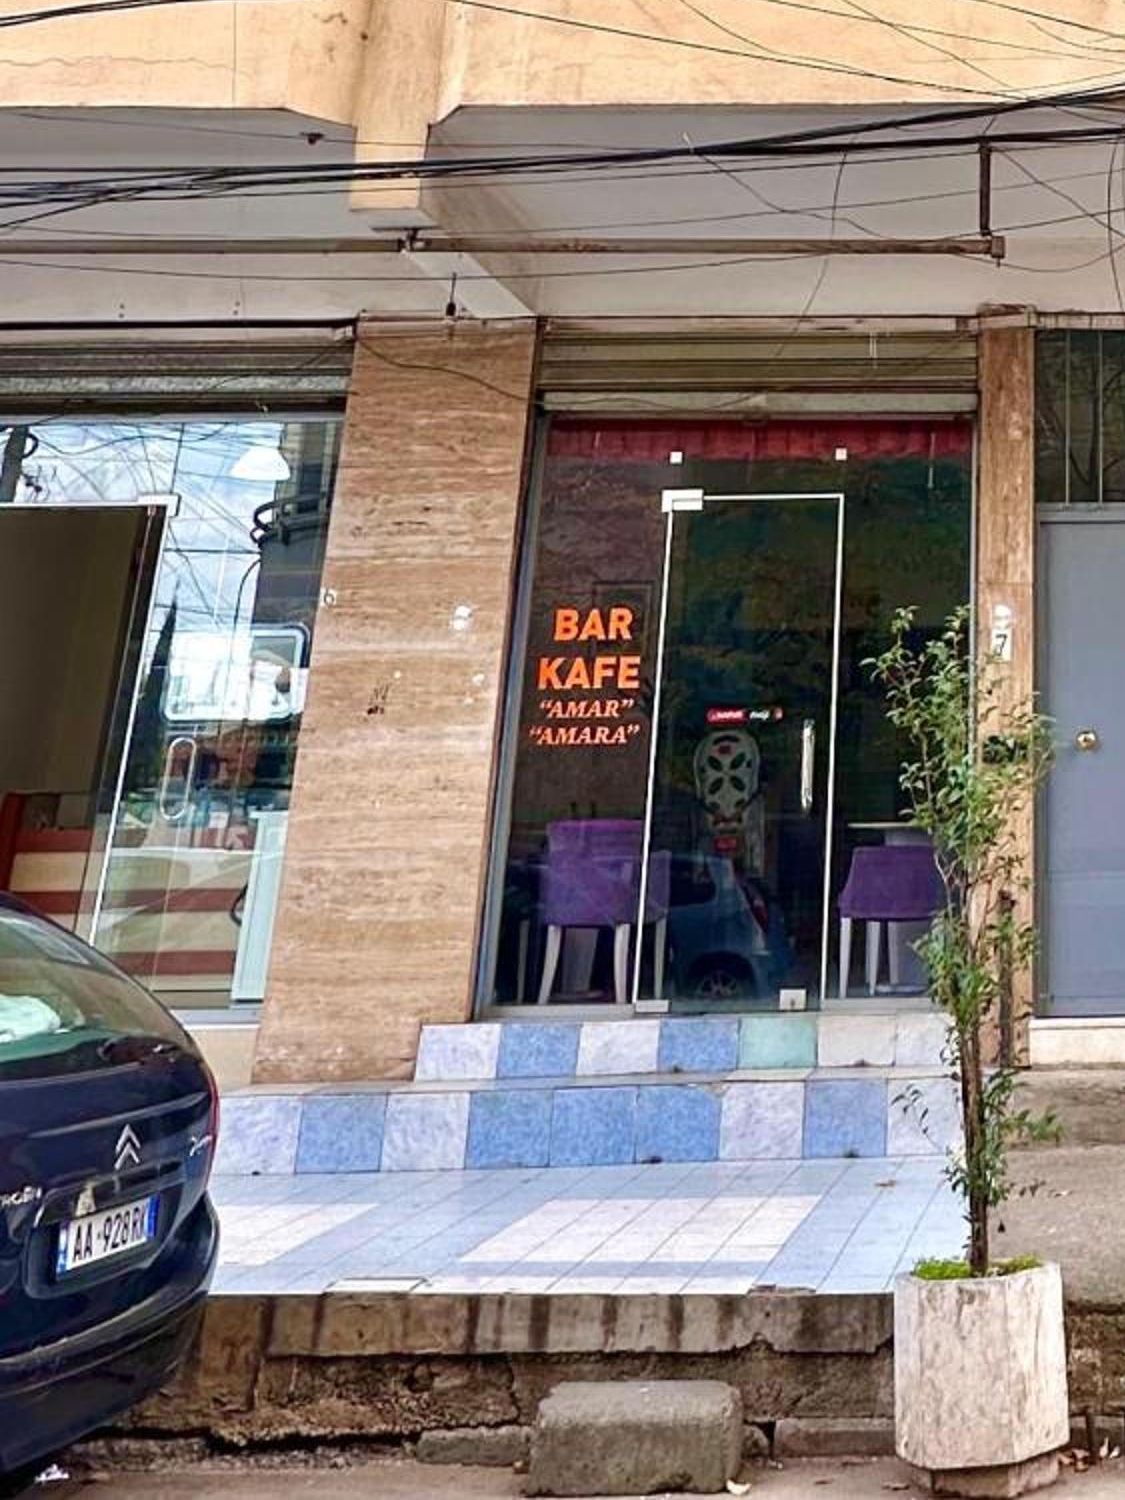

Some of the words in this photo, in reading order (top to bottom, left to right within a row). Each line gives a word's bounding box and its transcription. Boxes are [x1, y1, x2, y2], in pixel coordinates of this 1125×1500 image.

[553, 607, 633, 641] BAR
[995, 633, 1008, 656] 7
[537, 655, 641, 690] KAFE
[539, 699, 635, 718] “AMAR”
[529, 724, 641, 745] “AMARA”
[73, 1220, 94, 1262] AA
